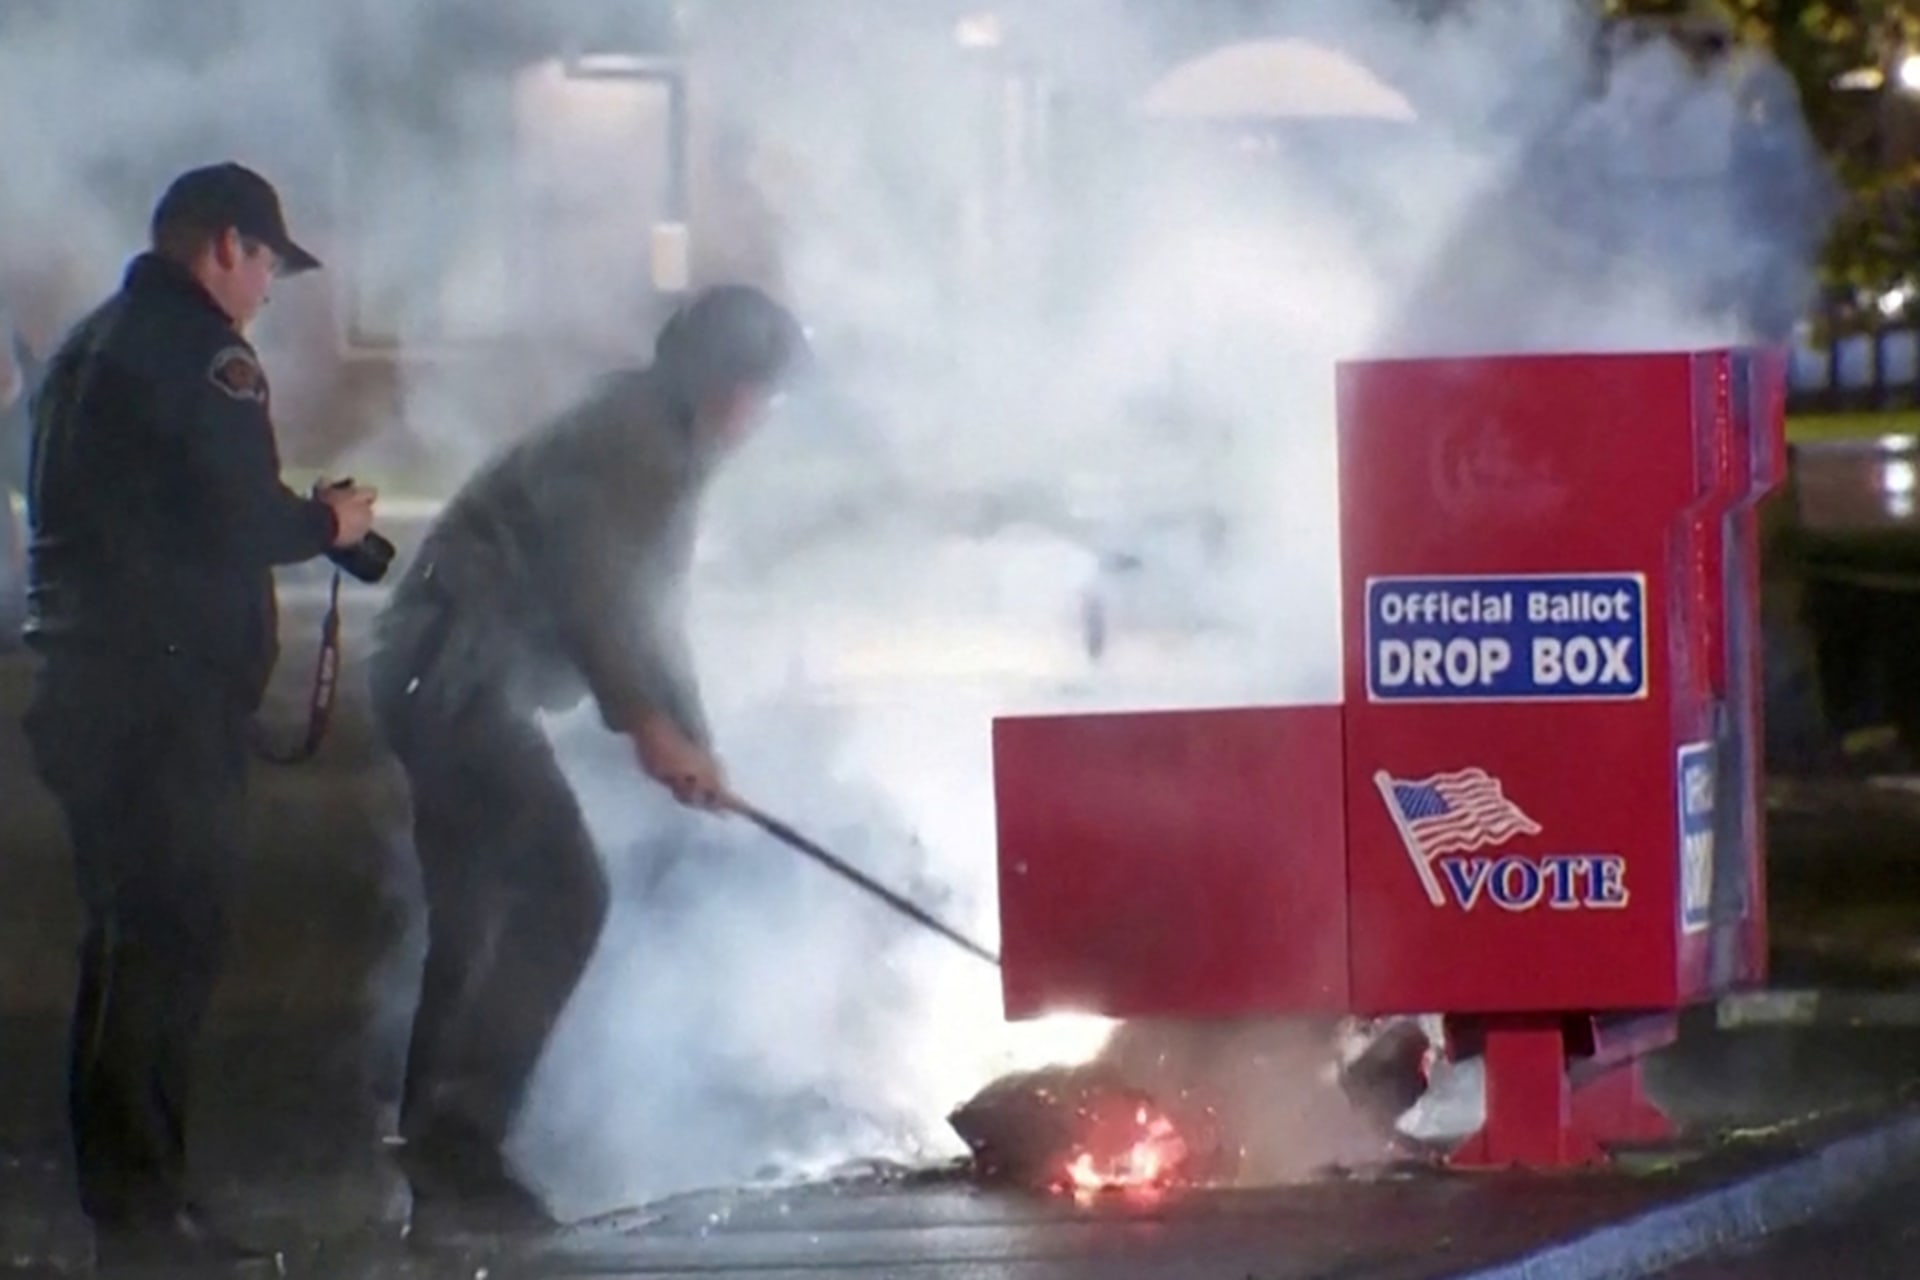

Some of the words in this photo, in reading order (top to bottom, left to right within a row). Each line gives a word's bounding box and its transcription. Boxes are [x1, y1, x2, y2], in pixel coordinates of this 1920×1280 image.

[1380, 592, 1512, 623] Official
[1528, 589, 1631, 622] Ballot
[1379, 638, 1511, 687] DROP
[1532, 636, 1633, 685] BOX
[1441, 857, 1629, 910] VOTE
